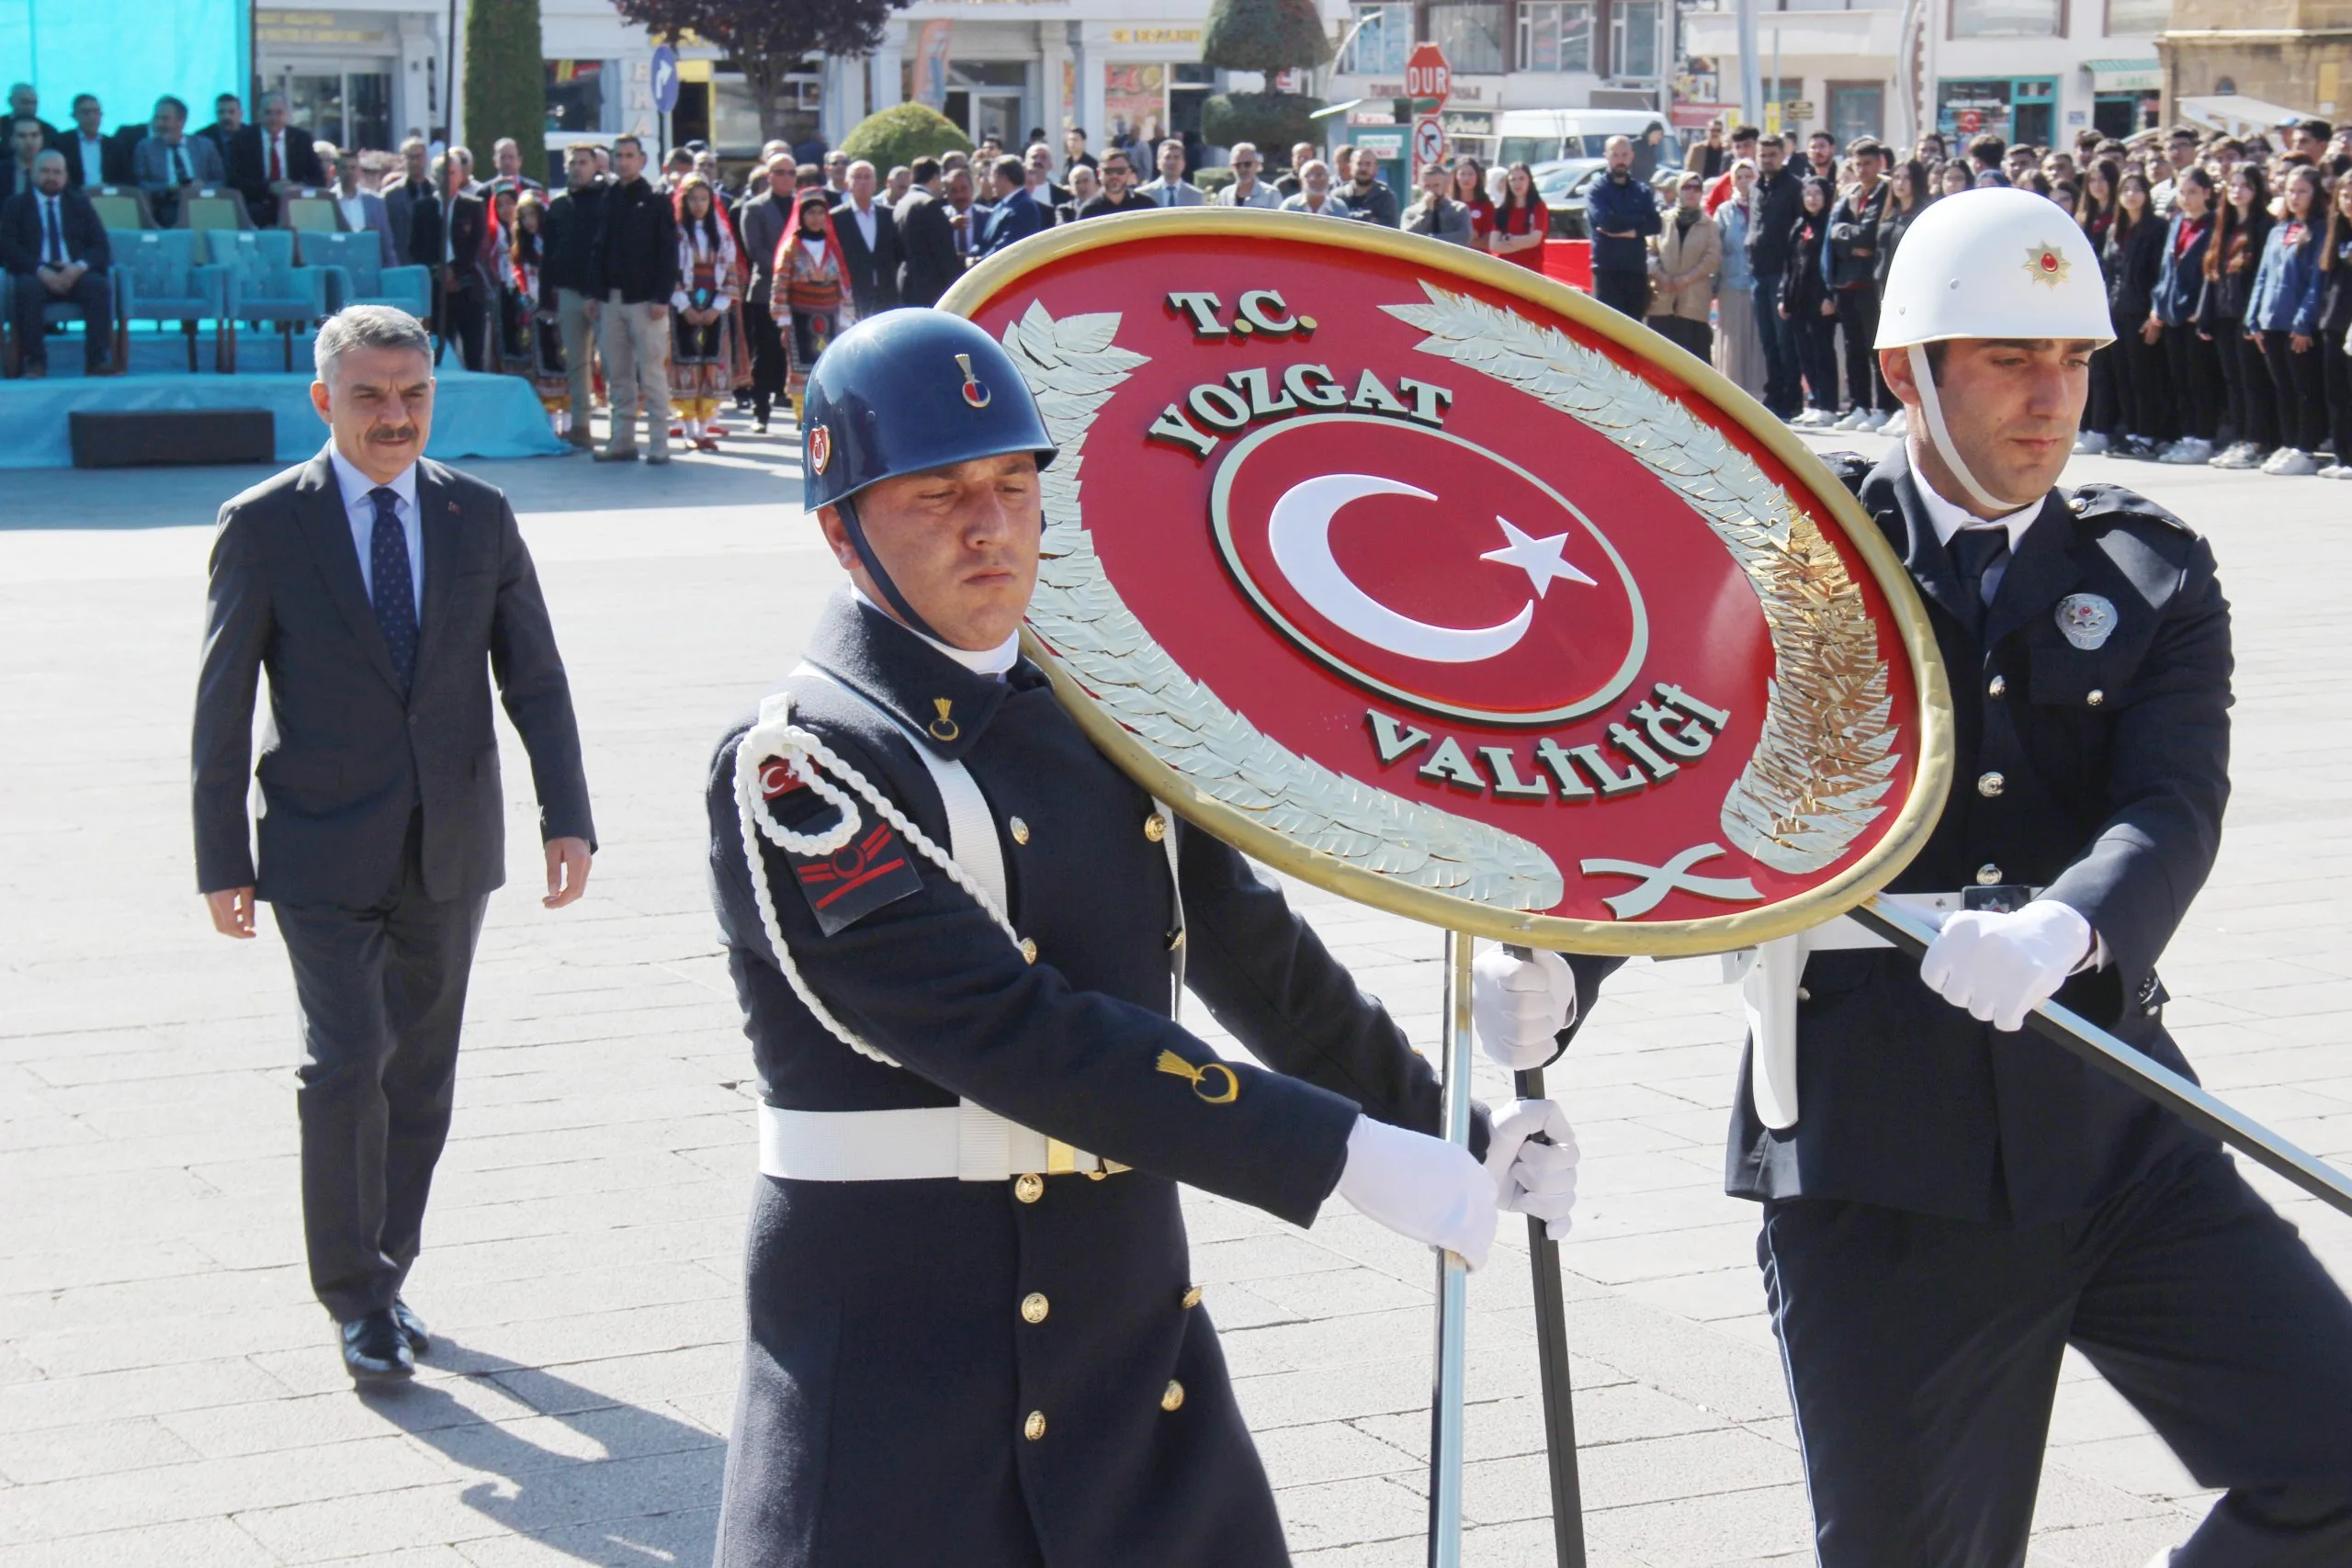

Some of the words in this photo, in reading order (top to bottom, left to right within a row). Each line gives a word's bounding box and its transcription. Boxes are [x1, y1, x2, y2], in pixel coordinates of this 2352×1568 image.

[1408, 67, 1448, 95] DUR
[1165, 289, 1317, 338] T.C.
[1148, 364, 1453, 458] YOZGAT
[1365, 682, 1731, 801] VALİLİĞİ
